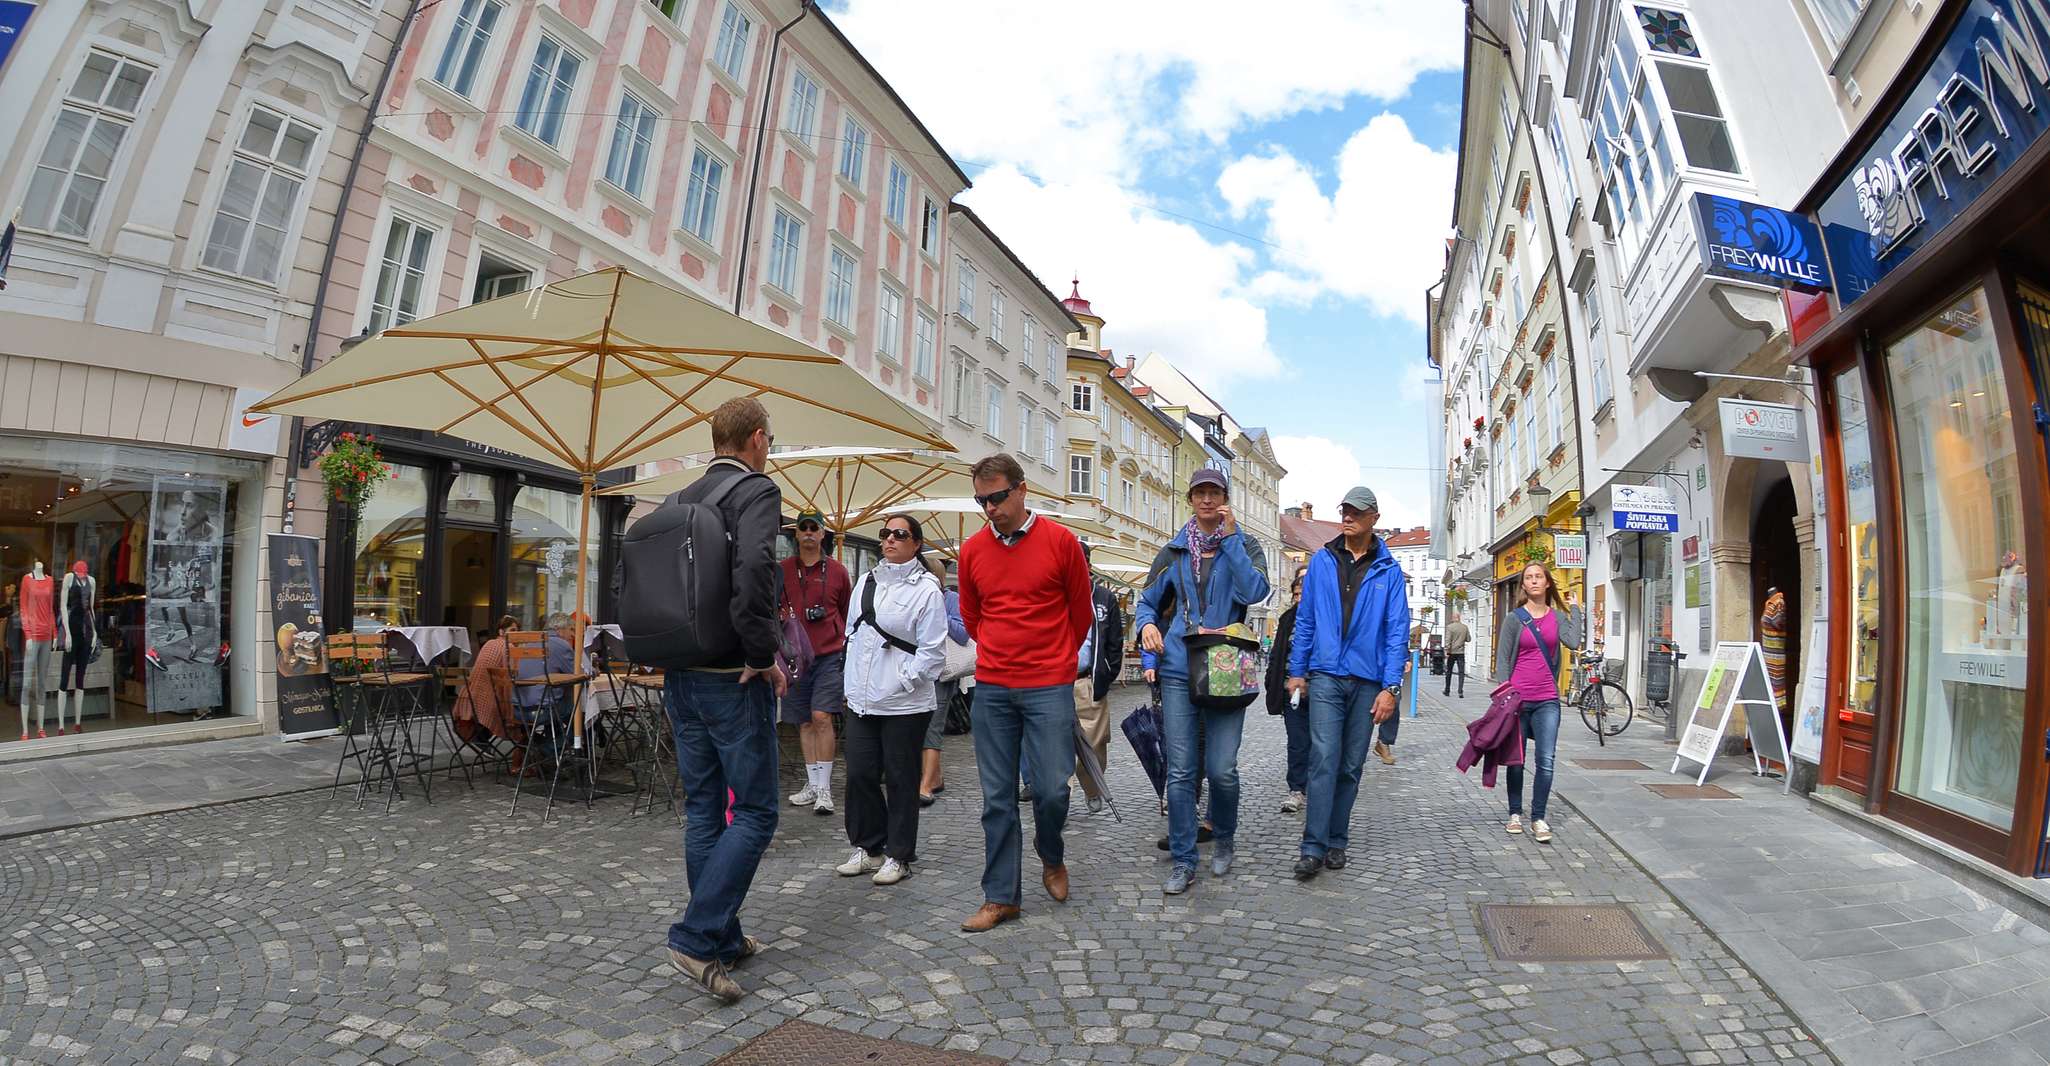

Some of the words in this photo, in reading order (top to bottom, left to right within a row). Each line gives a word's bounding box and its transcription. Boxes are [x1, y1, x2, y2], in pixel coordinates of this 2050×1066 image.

[1890, 0, 2050, 224] FREYW
[1709, 243, 1822, 282] FREYWILLE
[1735, 407, 1795, 431] POSVET
[465, 440, 482, 450] THE
[1626, 511, 1667, 523] ŠIVILJSKA
[1625, 521, 1669, 531] POPRAVILA
[1559, 548, 1583, 564] MAK
[276, 591, 316, 610] gibanica
[1959, 661, 2006, 678] FREYWILLE
